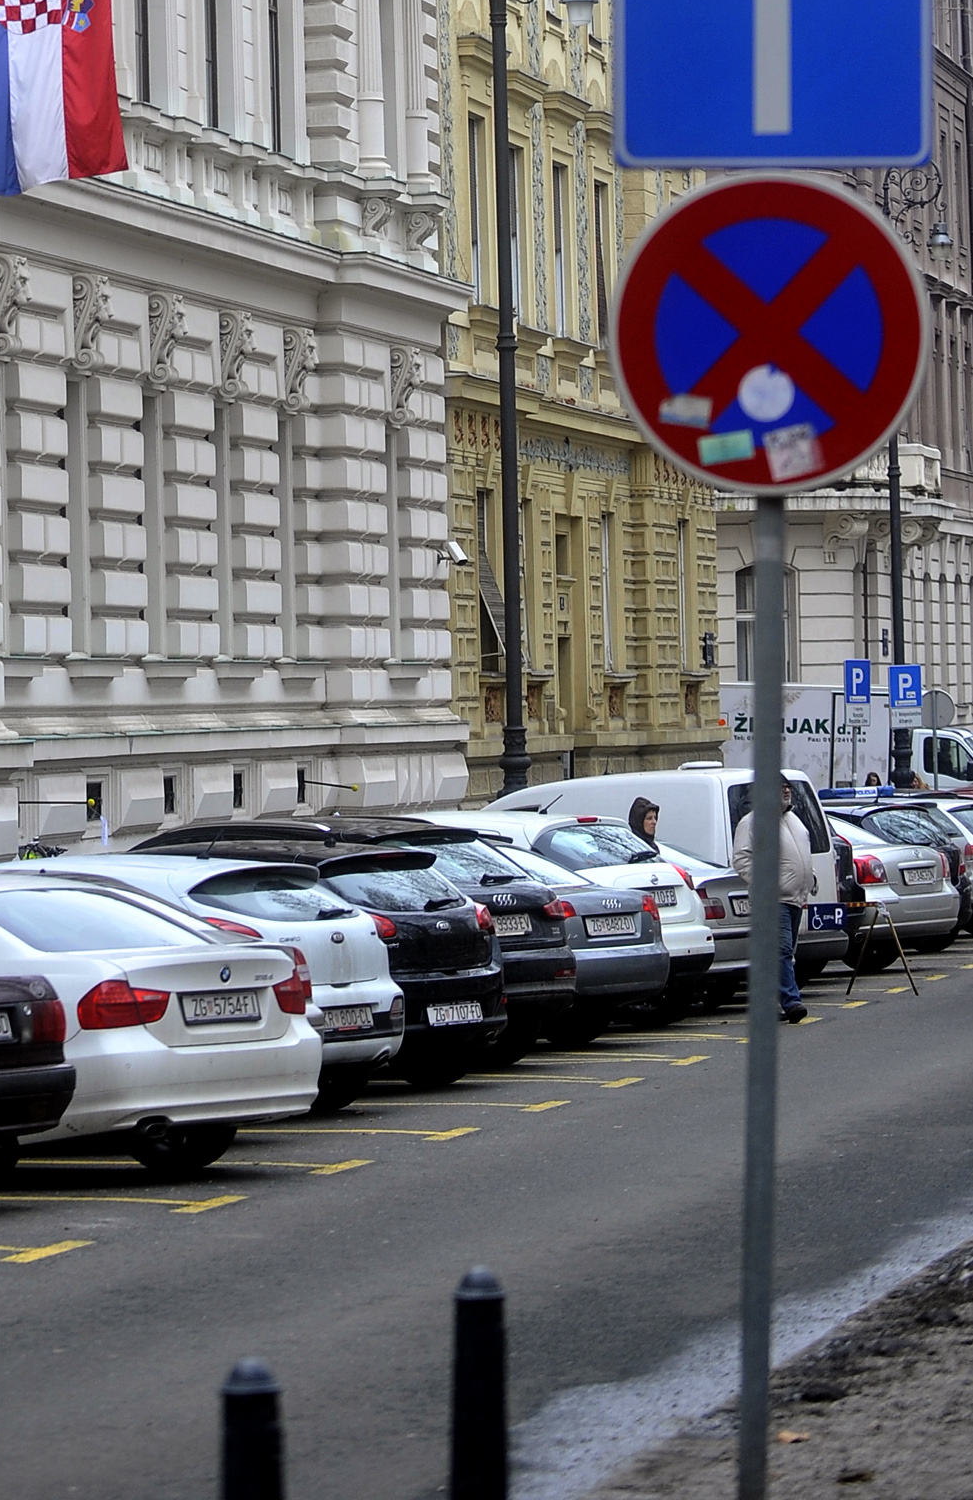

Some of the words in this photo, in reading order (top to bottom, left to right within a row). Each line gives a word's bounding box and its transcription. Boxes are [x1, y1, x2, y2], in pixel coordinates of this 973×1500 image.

[852, 667, 864, 695] P
[898, 673, 912, 699] P
[835, 908, 843, 924] P
[591, 919, 602, 932] ZG
[192, 997, 208, 1017] ZG
[433, 1008, 446, 1022] ZG
[341, 1008, 371, 1026] 800-CL
